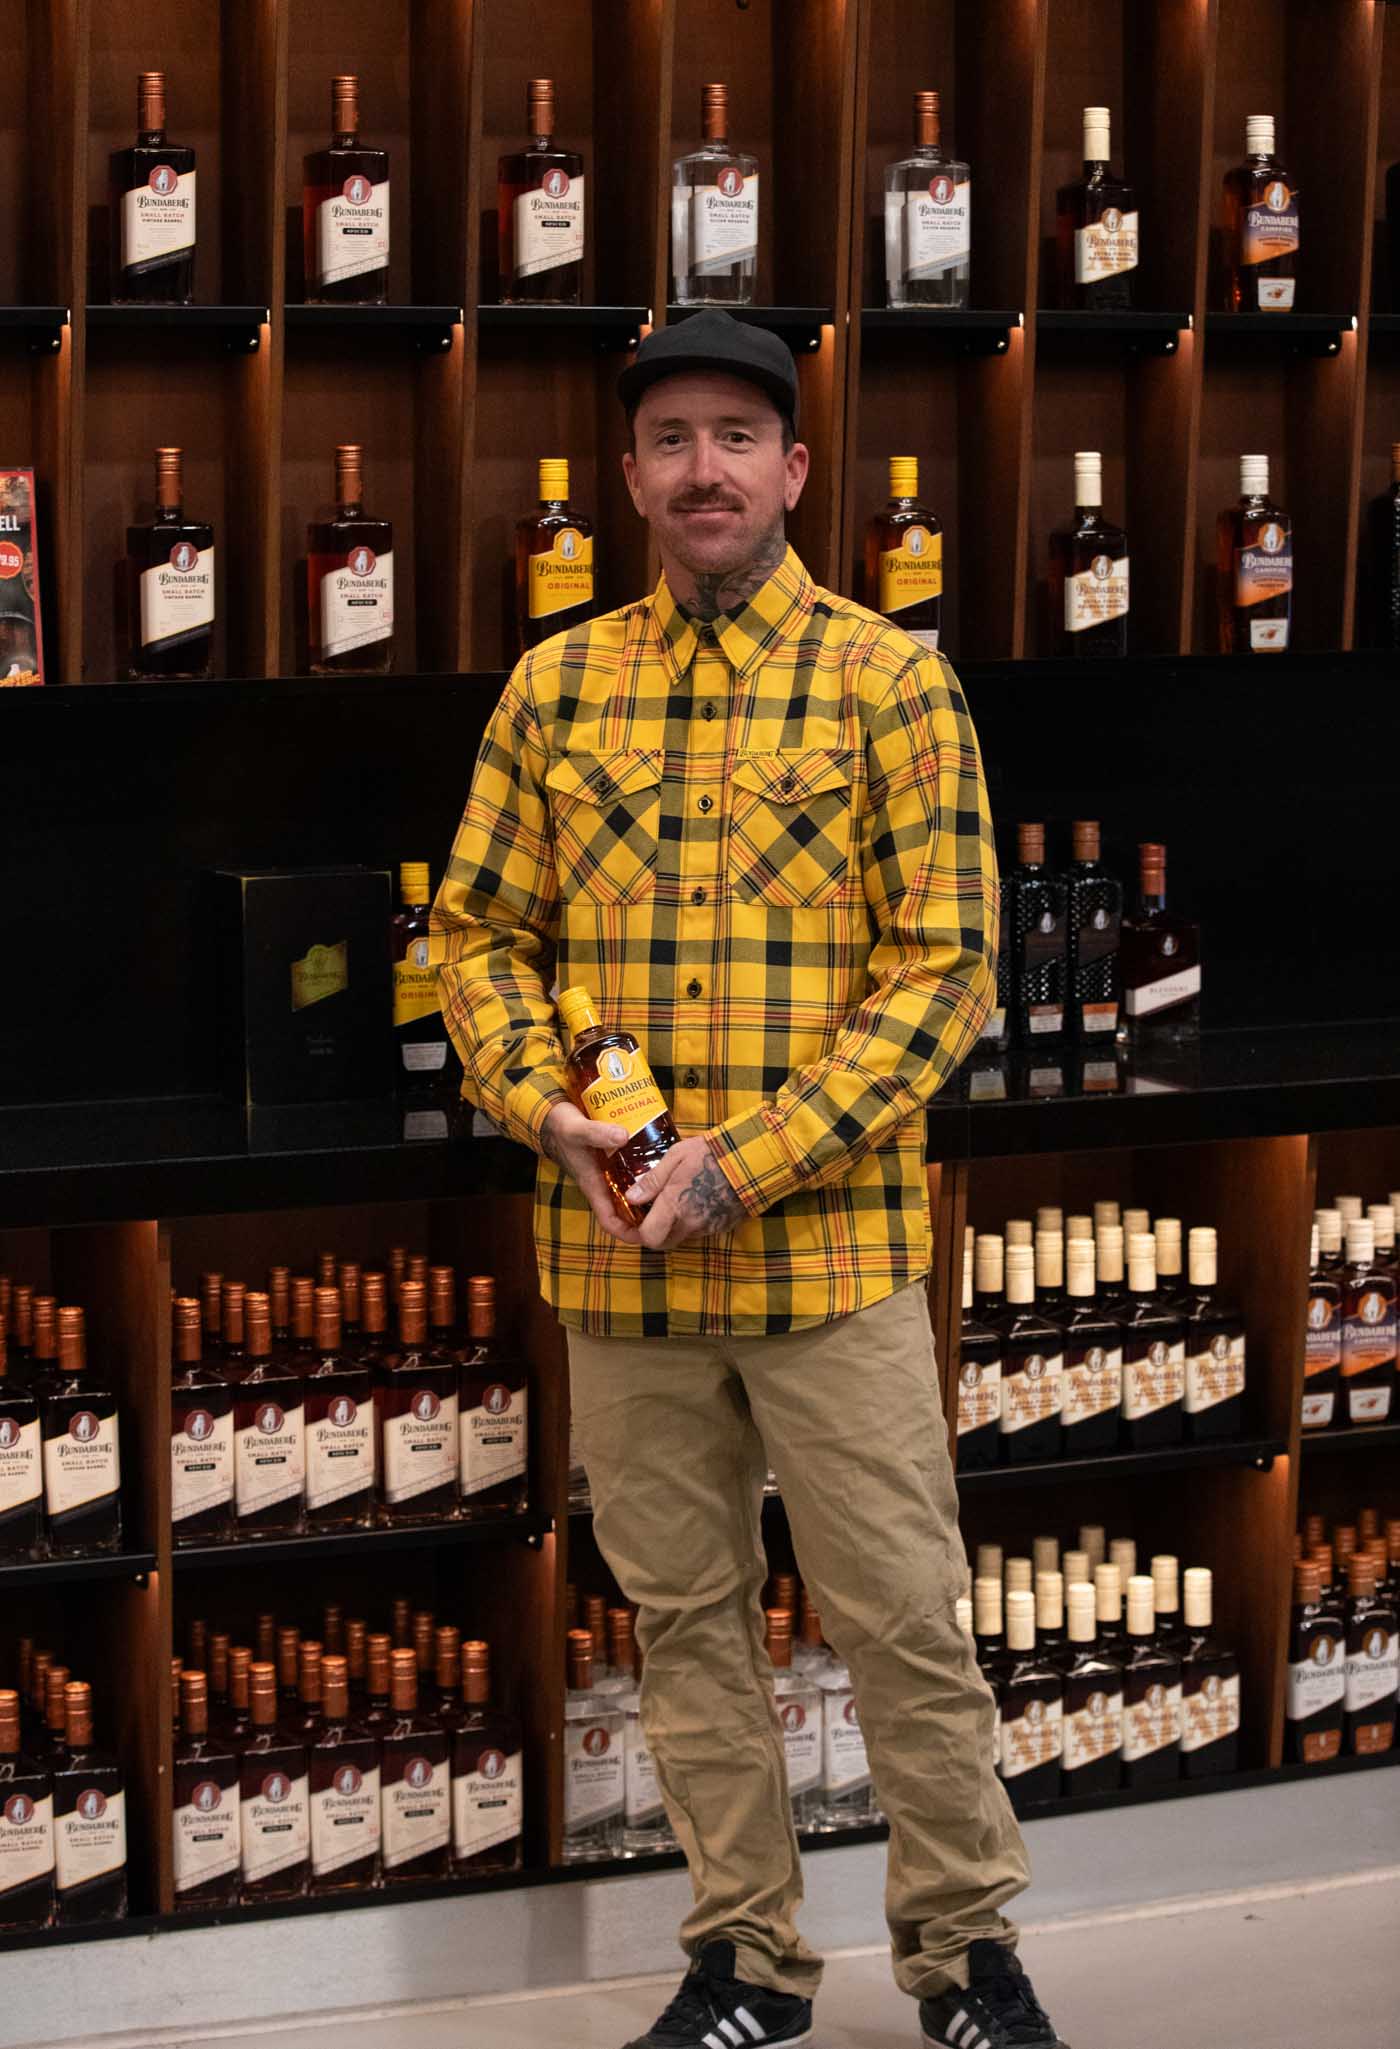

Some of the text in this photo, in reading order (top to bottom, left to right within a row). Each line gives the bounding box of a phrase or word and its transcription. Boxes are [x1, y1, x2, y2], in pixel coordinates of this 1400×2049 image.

[137, 195, 190, 208] BUNDABERG
[531, 199, 580, 211] BUNDABERG
[706, 196, 754, 209] BUNDABERG
[332, 205, 383, 217] BUNDABERG
[918, 204, 966, 216] BUNDABERG
[159, 572, 209, 585] BUNDABERG
[336, 577, 387, 590] BUNDABERG
[609, 1096, 658, 1118] ORIGINAL
[400, 1422, 452, 1435] BUNDABERG
[471, 1415, 523, 1429] BUNDABERG
[317, 1428, 368, 1442] BUNDABERG
[244, 1435, 296, 1449] BUNDABERG
[57, 1442, 112, 1457] BUNDABERG
[172, 1442, 226, 1456] BUNDABERG
[65, 1820, 119, 1834] BUNDABERG
